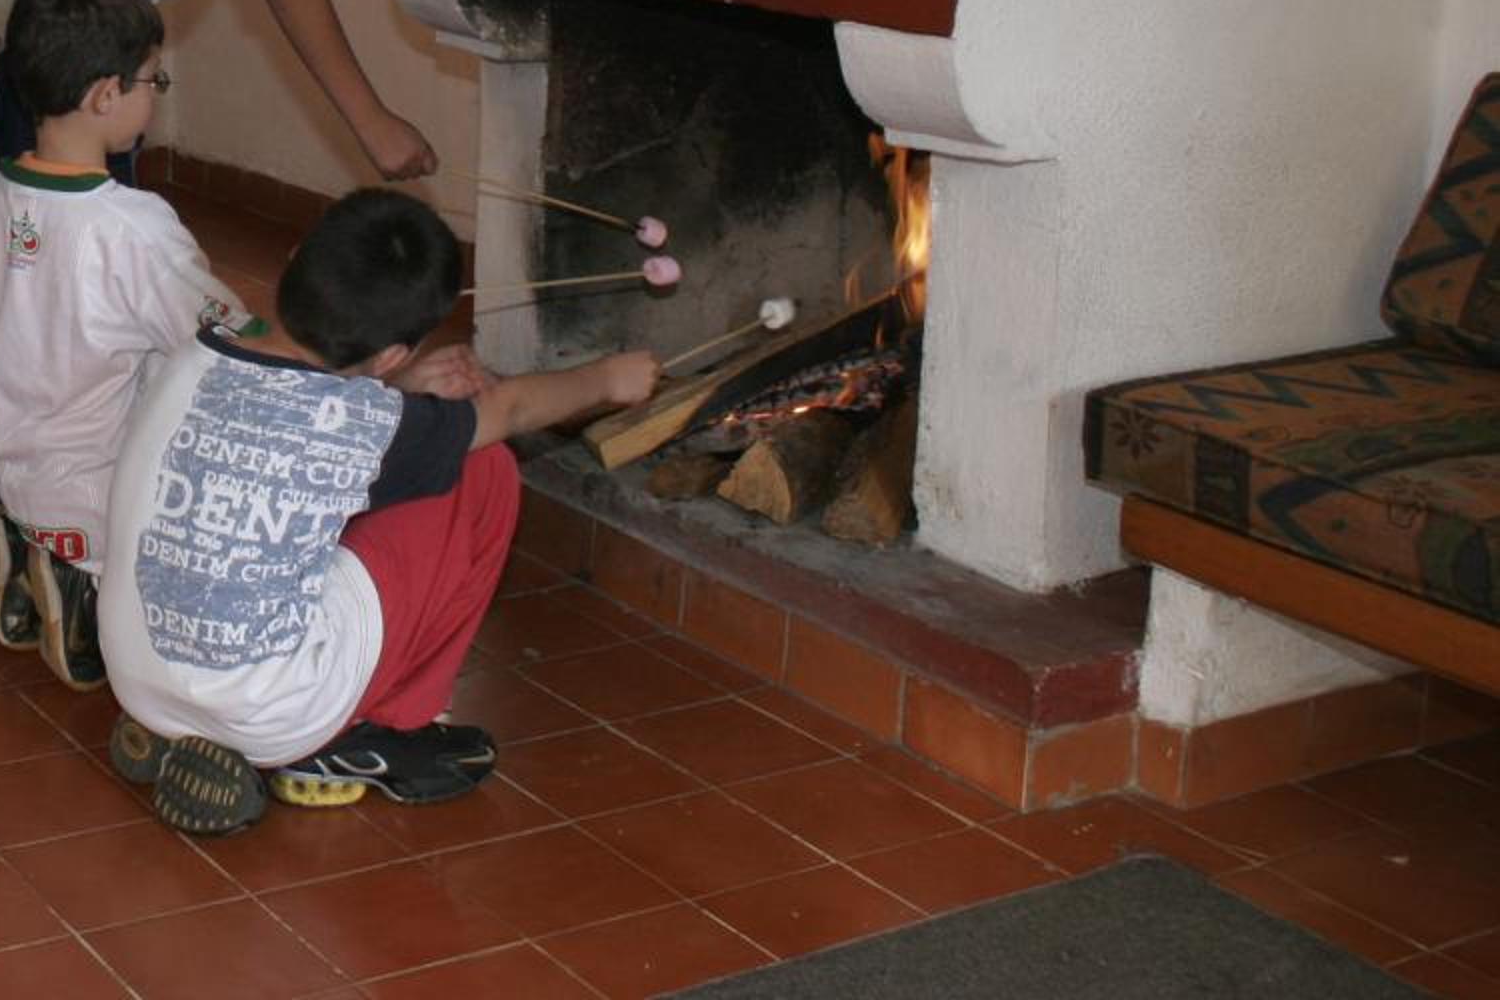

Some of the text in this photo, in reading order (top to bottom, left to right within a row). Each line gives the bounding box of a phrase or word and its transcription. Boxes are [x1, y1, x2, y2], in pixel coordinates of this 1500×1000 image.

[172, 426, 296, 478] DENIM
[144, 536, 229, 579] DENIM
[146, 604, 248, 645] DENIM
